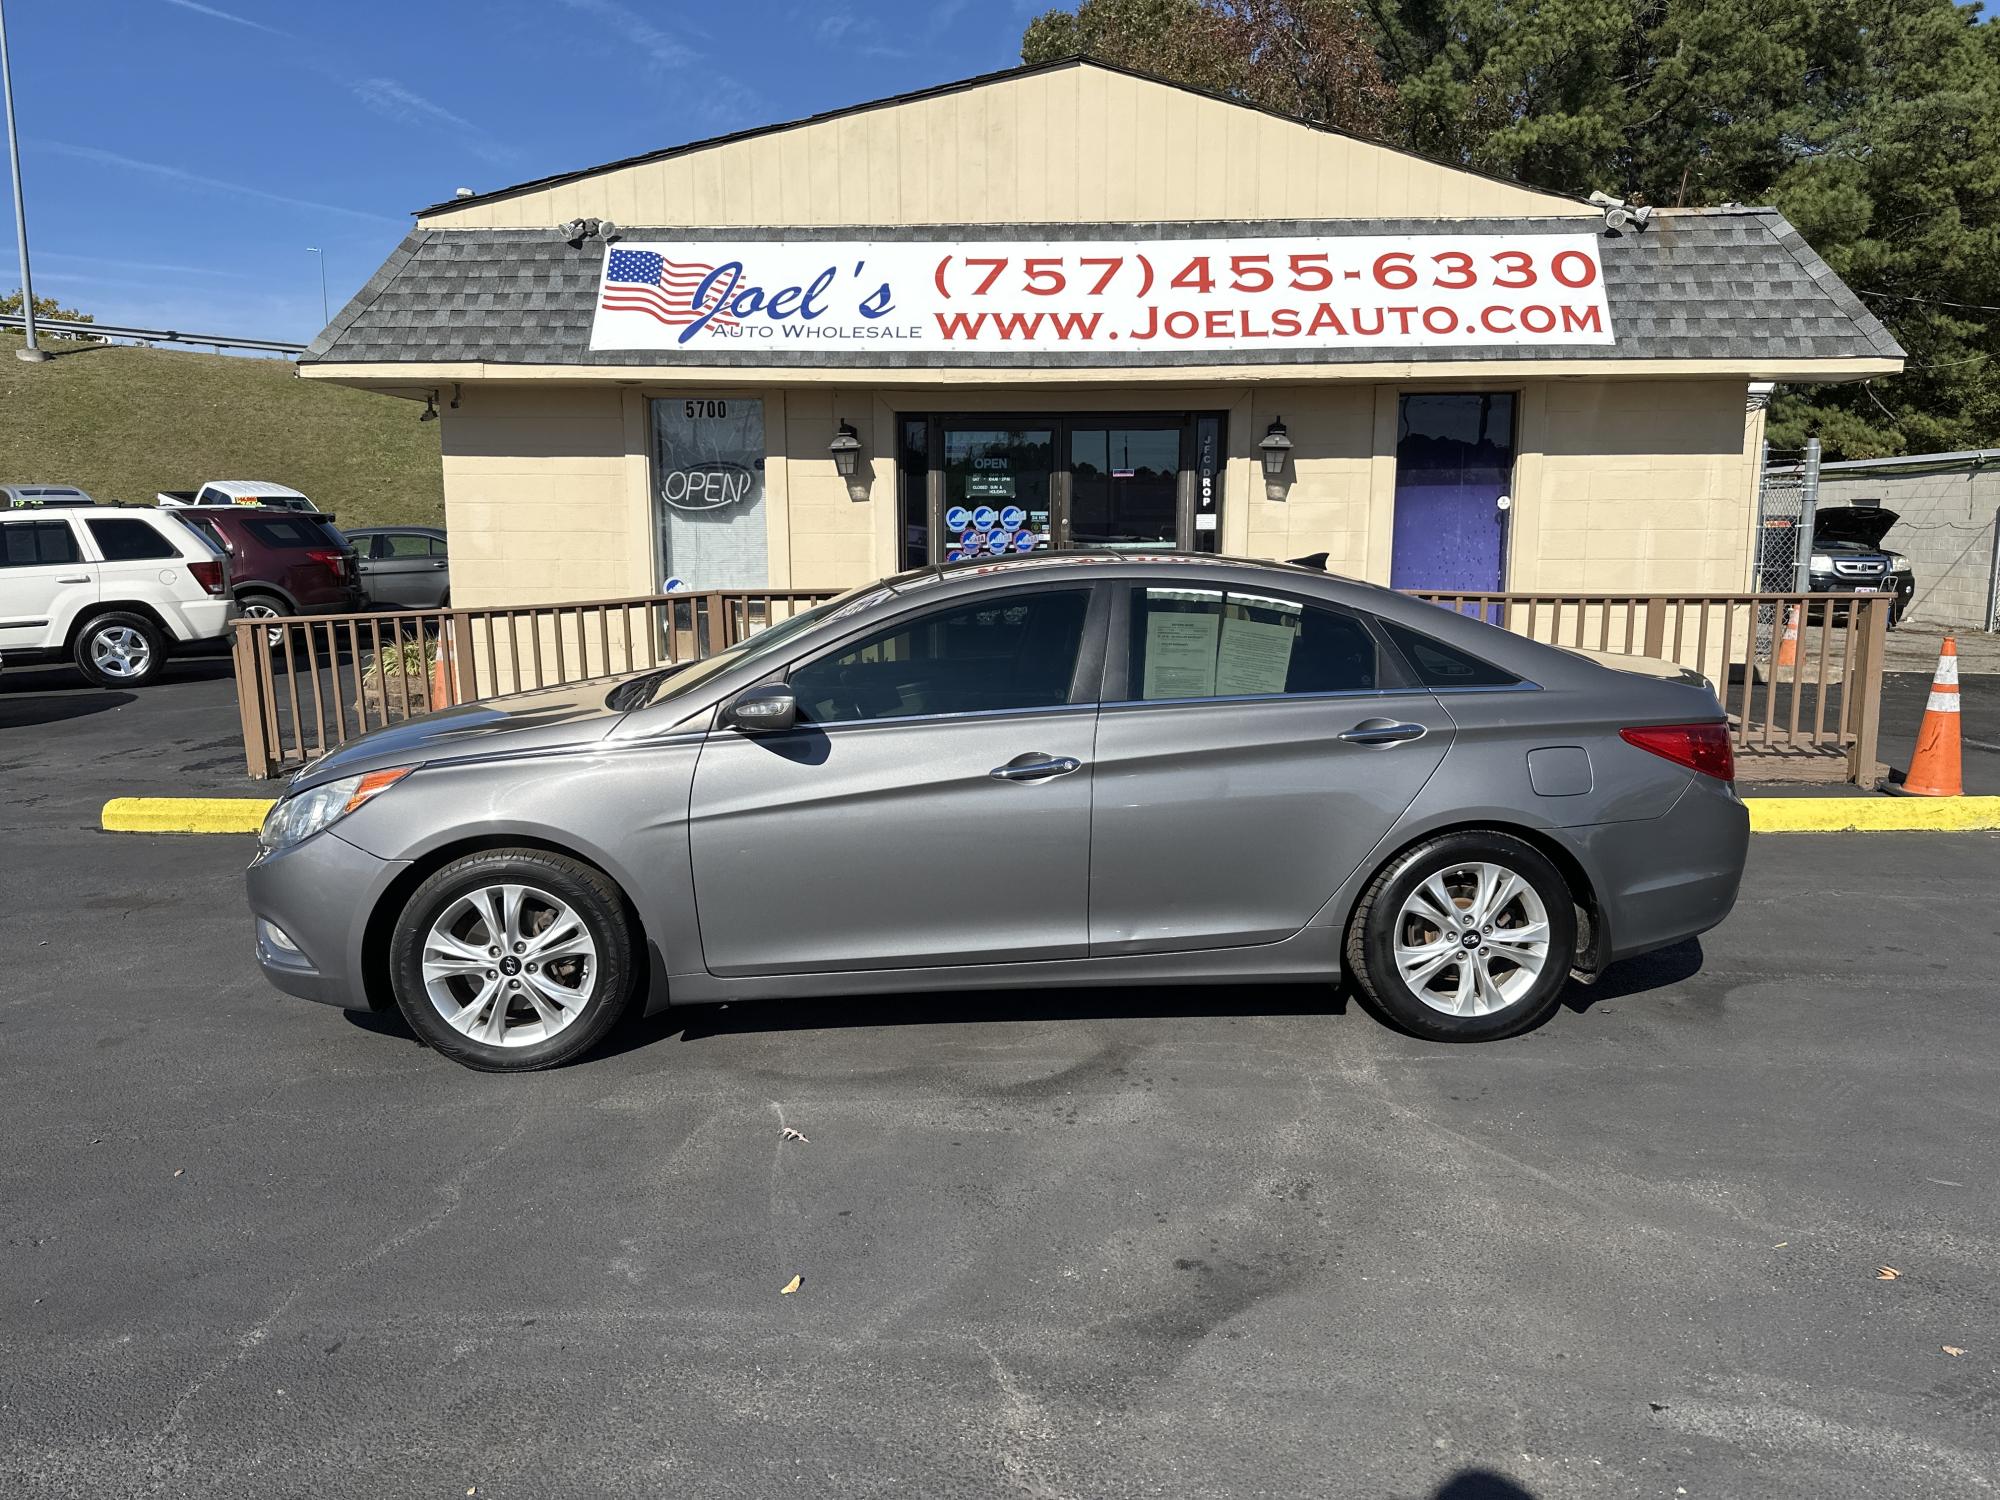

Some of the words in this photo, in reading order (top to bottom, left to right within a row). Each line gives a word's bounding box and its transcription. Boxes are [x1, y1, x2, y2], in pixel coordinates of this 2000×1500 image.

[678, 261, 896, 344] Joel's
[685, 400, 727, 419] 5700
[974, 457, 1008, 469] OPEN
[665, 471, 744, 502] OPEN
